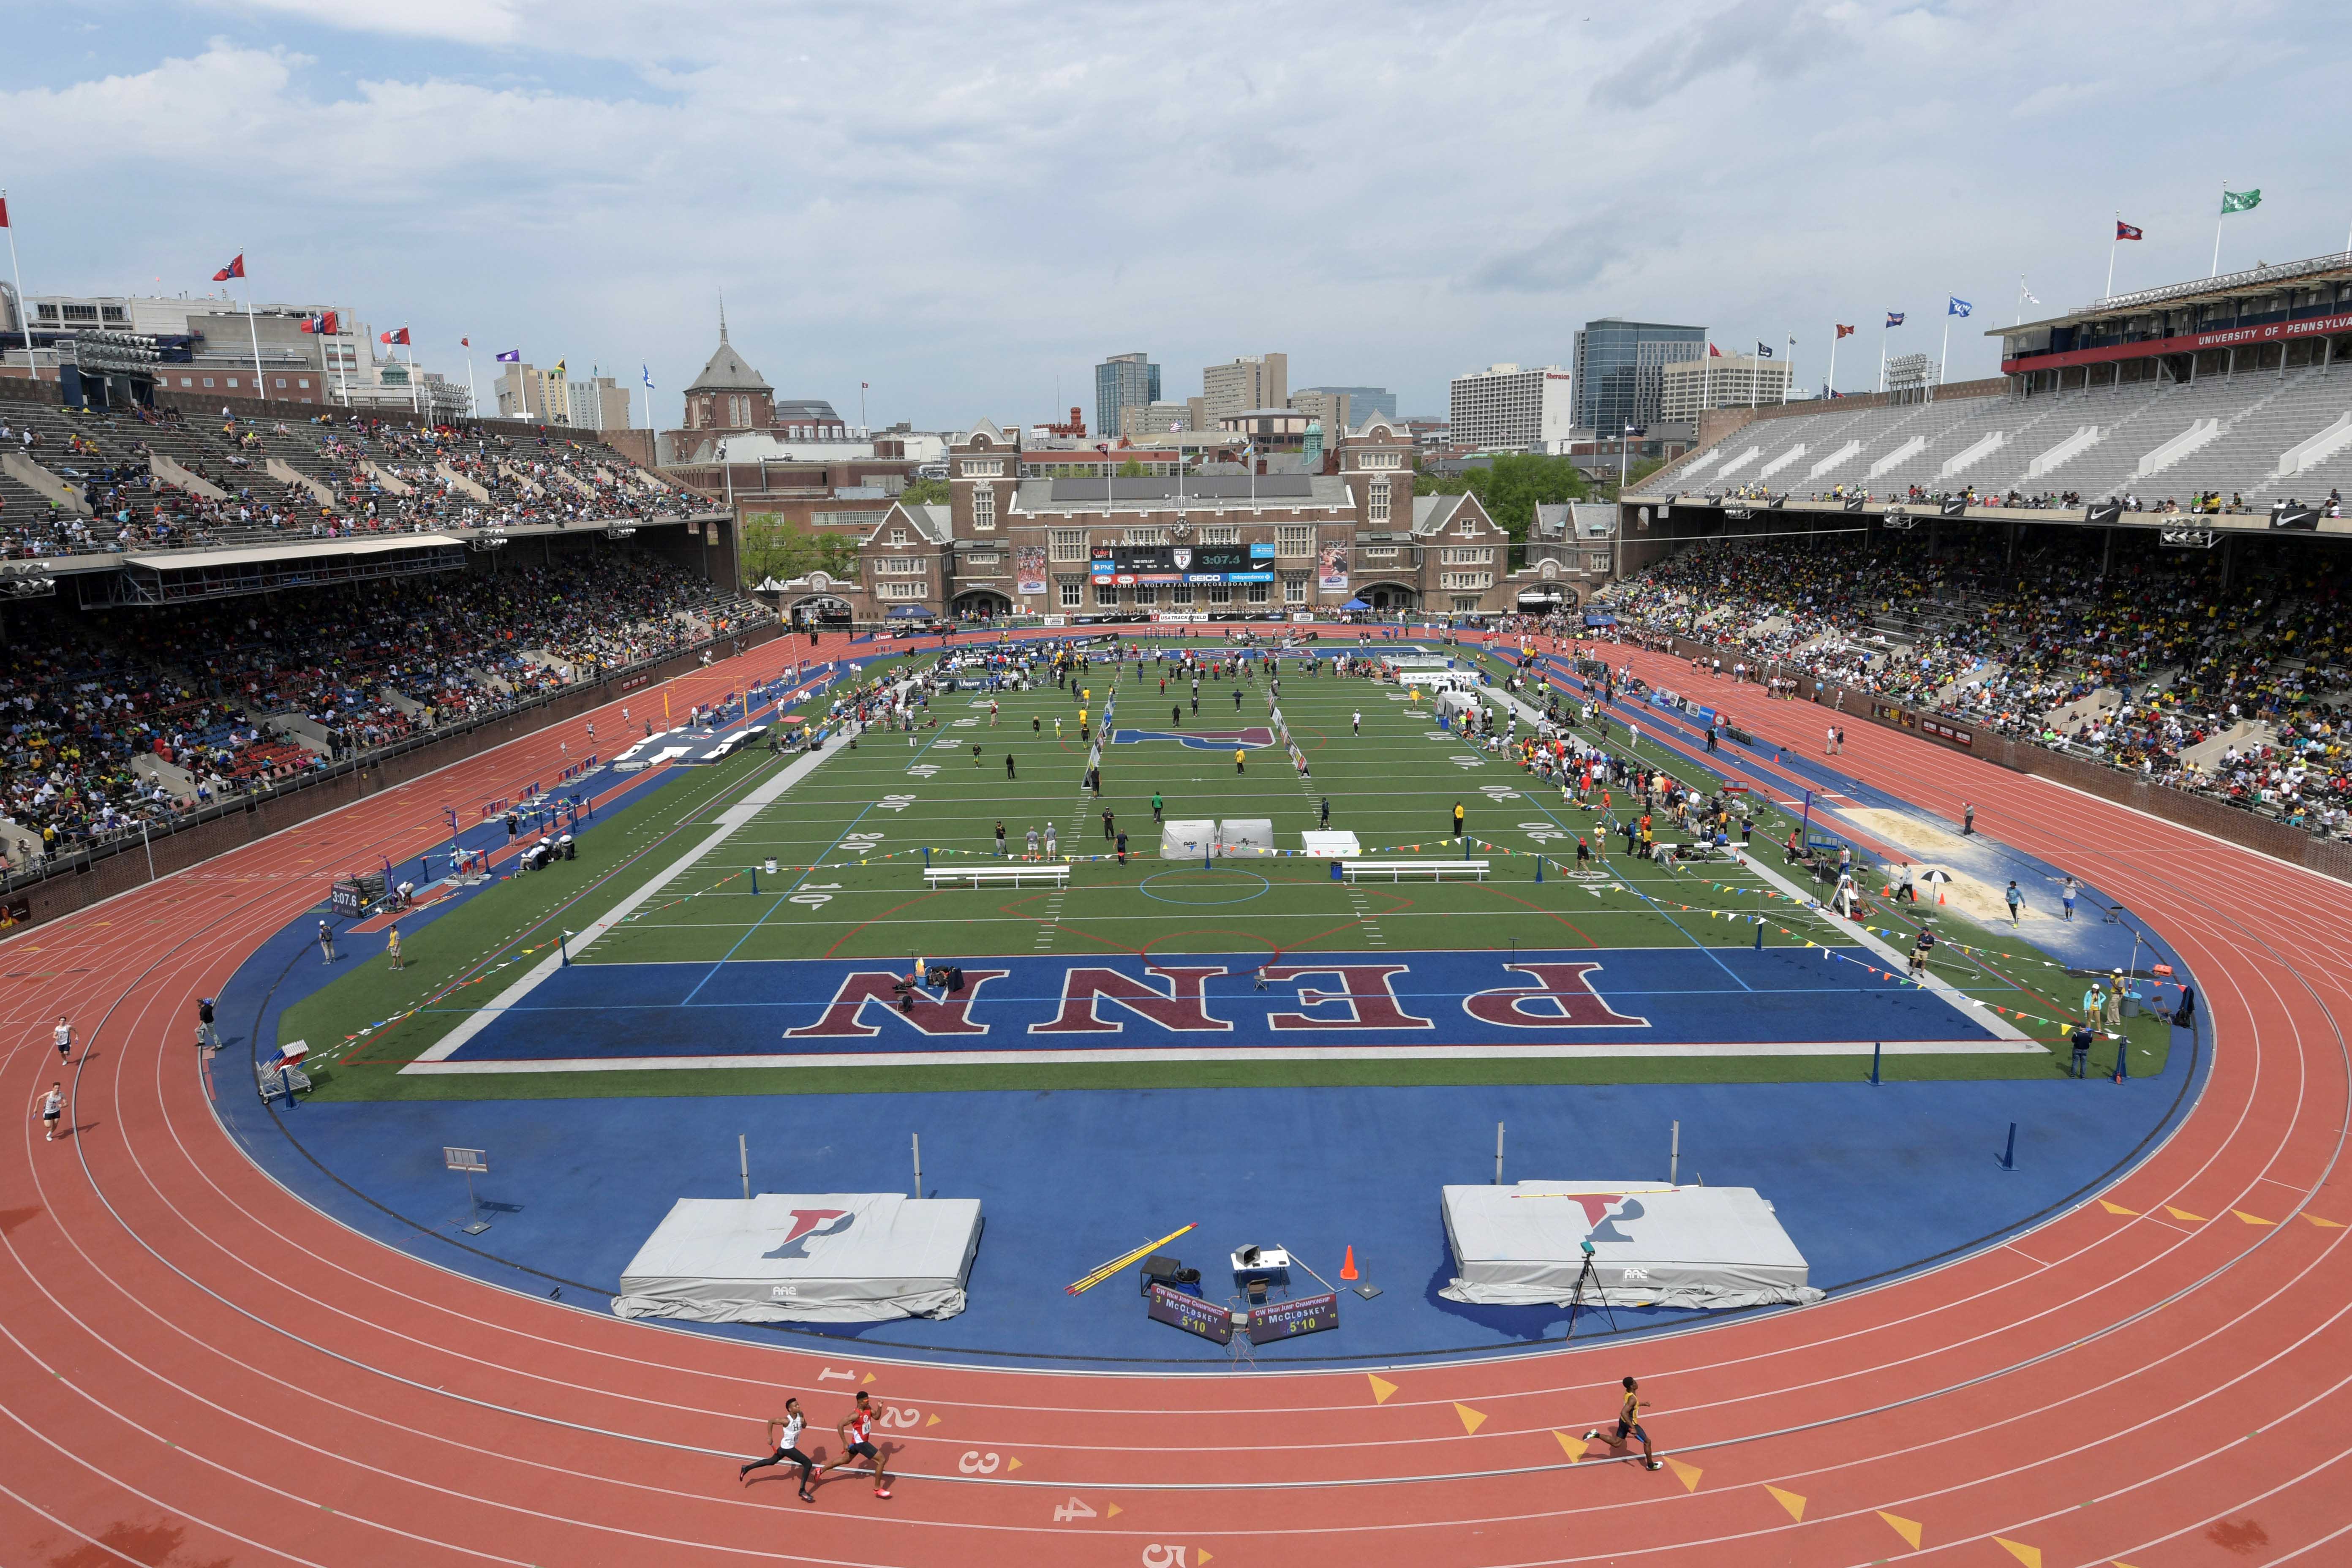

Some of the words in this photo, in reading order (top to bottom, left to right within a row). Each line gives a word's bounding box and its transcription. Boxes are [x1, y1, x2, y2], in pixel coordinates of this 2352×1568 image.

[2199, 329, 2257, 345] UNIVERSITY
[2265, 327, 2278, 337] OF
[2287, 317, 2352, 334] PENNSYLVA
[1202, 555, 1240, 565] 3:07.4
[952, 719, 980, 727] 40
[1424, 732, 1457, 740] 50
[931, 740, 963, 749] 50
[1448, 756, 1486, 766] 40
[907, 764, 942, 775] 40
[1479, 786, 1521, 798] 30
[877, 795, 916, 808] 30
[1517, 822, 1568, 838] 20
[838, 833, 885, 849] 20
[1567, 871, 1626, 890] 10
[332, 890, 357, 907] 3:07.6
[789, 882, 843, 903] 10
[783, 962, 1652, 1038] PENN
[1567, 1194, 1645, 1242] P
[761, 1209, 855, 1259] P
[1156, 1288, 1166, 1296] CW
[1156, 1295, 1161, 1303] 3
[1257, 1318, 1263, 1326] 3
[817, 1367, 856, 1381] 1
[879, 1406, 920, 1428] 2
[793, 1424, 799, 1432] H
[958, 1451, 1000, 1474] 3
[1053, 1497, 1097, 1522] 4
[1142, 1544, 1186, 1568] 5
